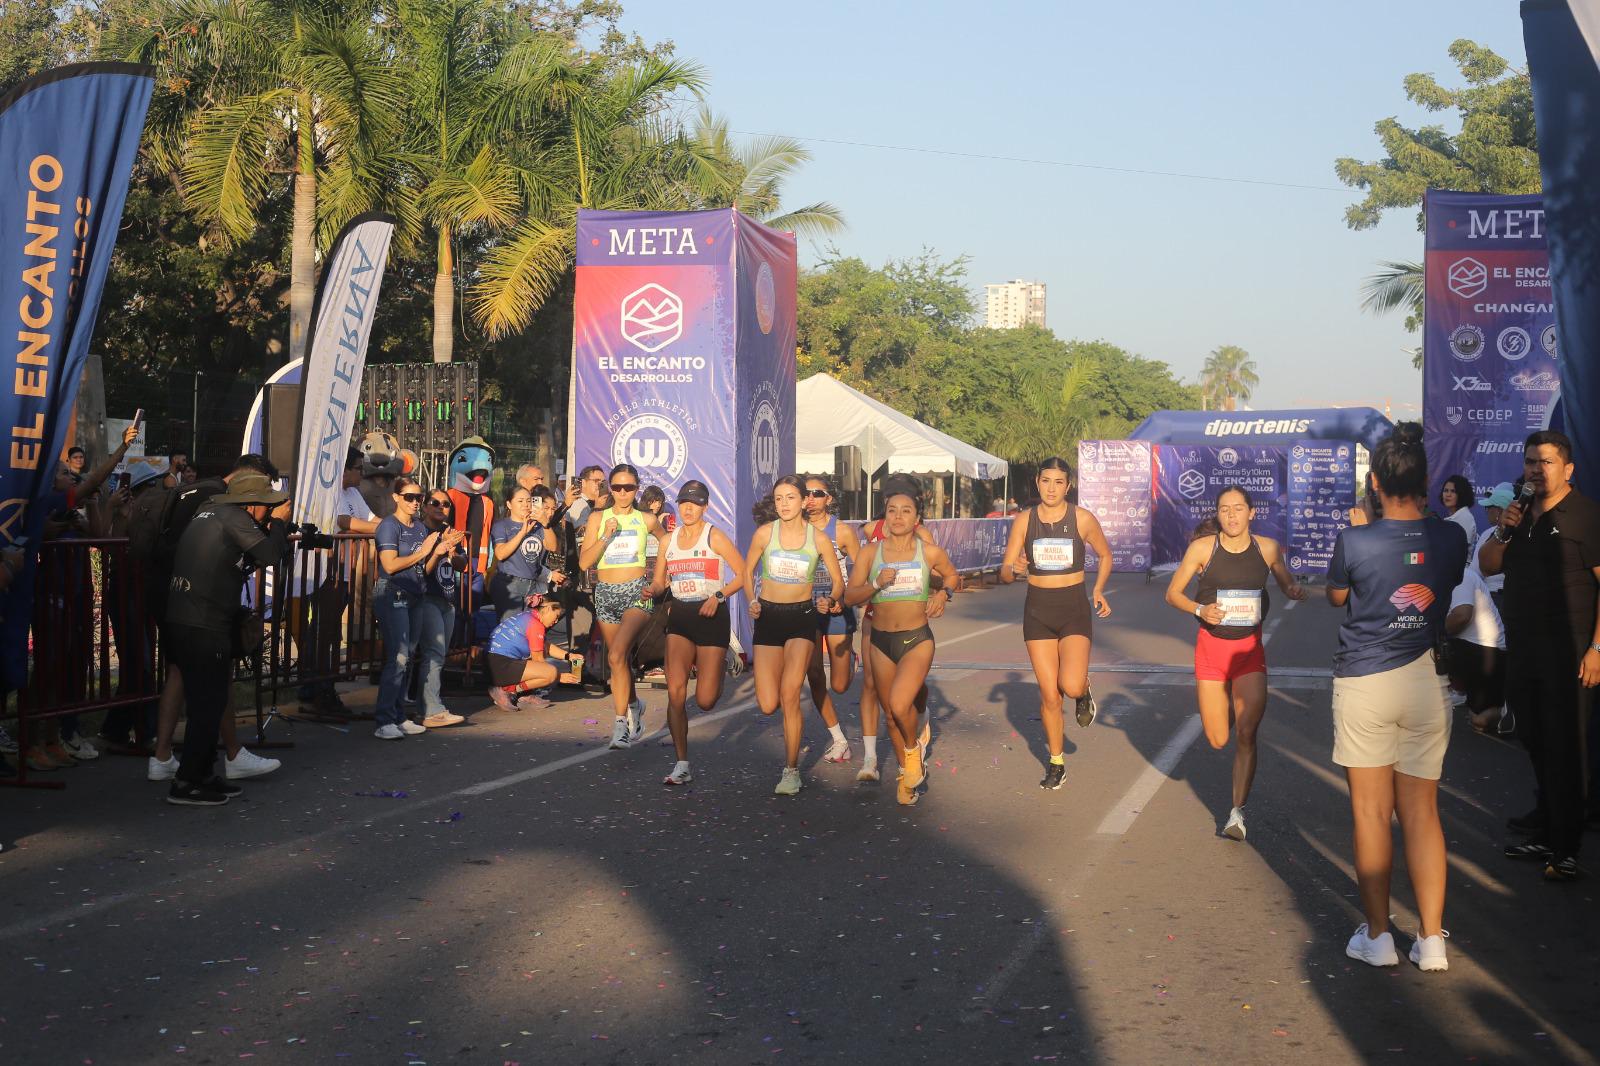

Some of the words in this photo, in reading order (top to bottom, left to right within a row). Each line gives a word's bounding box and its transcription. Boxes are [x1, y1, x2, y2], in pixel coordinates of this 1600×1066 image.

[1467, 209, 1546, 239] MET
[608, 228, 698, 256] META
[15, 154, 63, 398] ENCANTO
[1493, 267, 1511, 278] EL
[1515, 267, 1550, 278] ENCA
[598, 356, 618, 370] EL
[623, 356, 706, 370] ENCANTO
[610, 374, 693, 383] DESARROLLOS
[606, 401, 639, 429] WORLD
[643, 398, 697, 431] ATHLETICS
[1467, 409, 1513, 421] CEDEP
[1204, 419, 1311, 437] dportenis
[10, 413, 45, 470] EL
[1212, 468, 1241, 476] Carrera
[1209, 477, 1222, 485] EL
[1224, 477, 1275, 486] ENCANTO
[678, 580, 697, 593] 128
